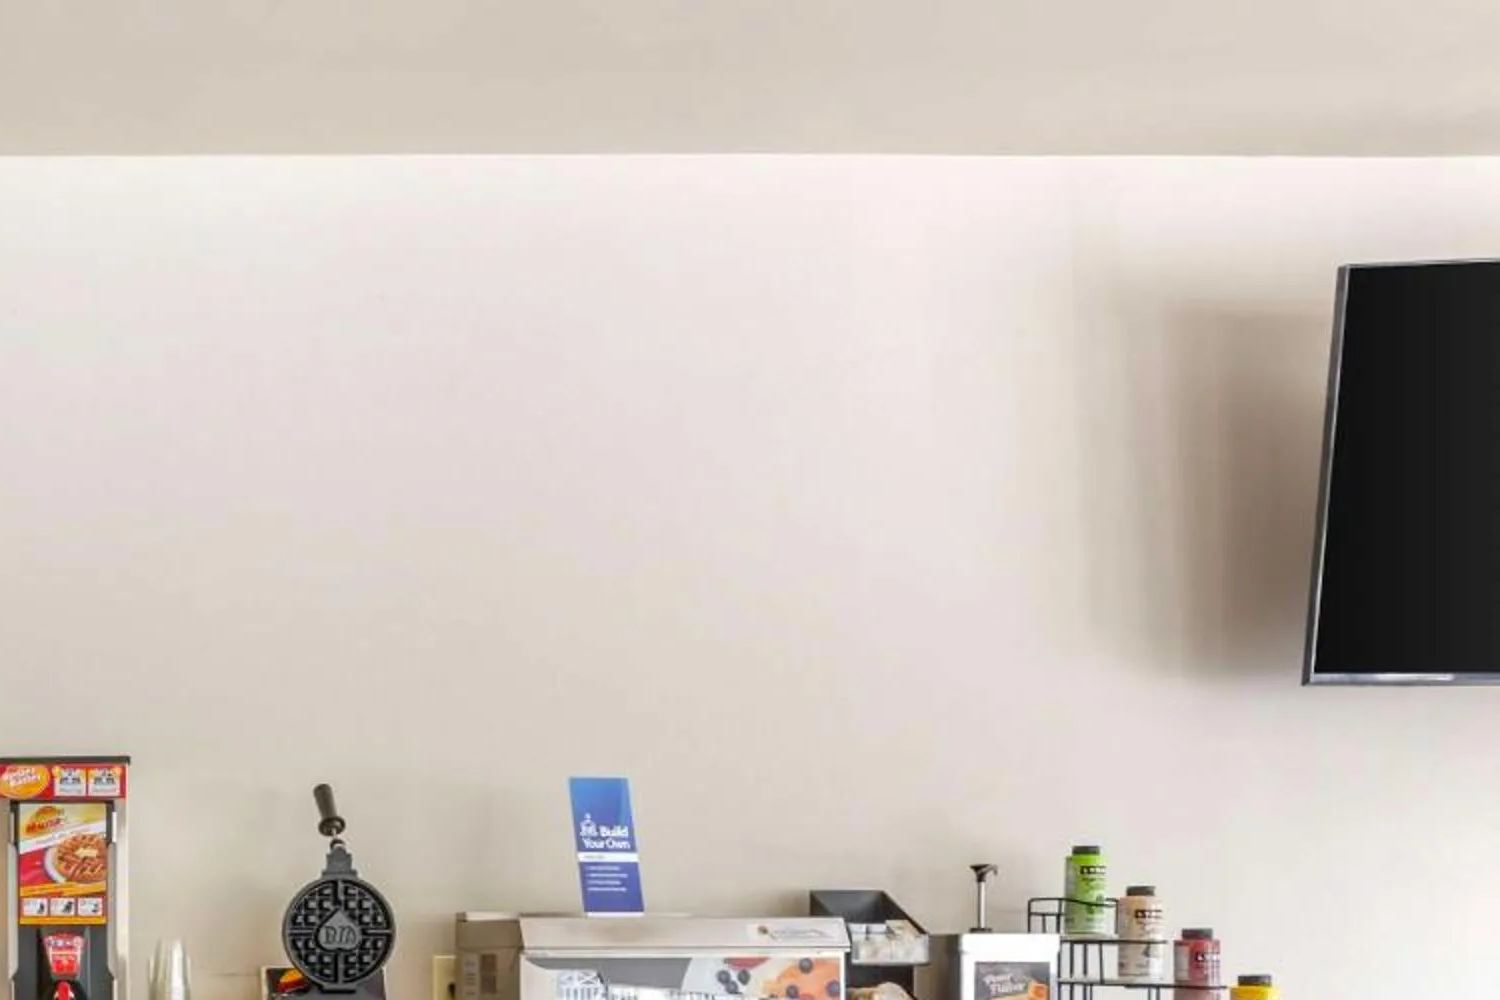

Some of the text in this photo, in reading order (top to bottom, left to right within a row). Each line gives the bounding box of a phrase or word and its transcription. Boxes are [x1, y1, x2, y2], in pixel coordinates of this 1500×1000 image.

[599, 825, 629, 837] Build
[582, 837, 631, 849] Your Own
